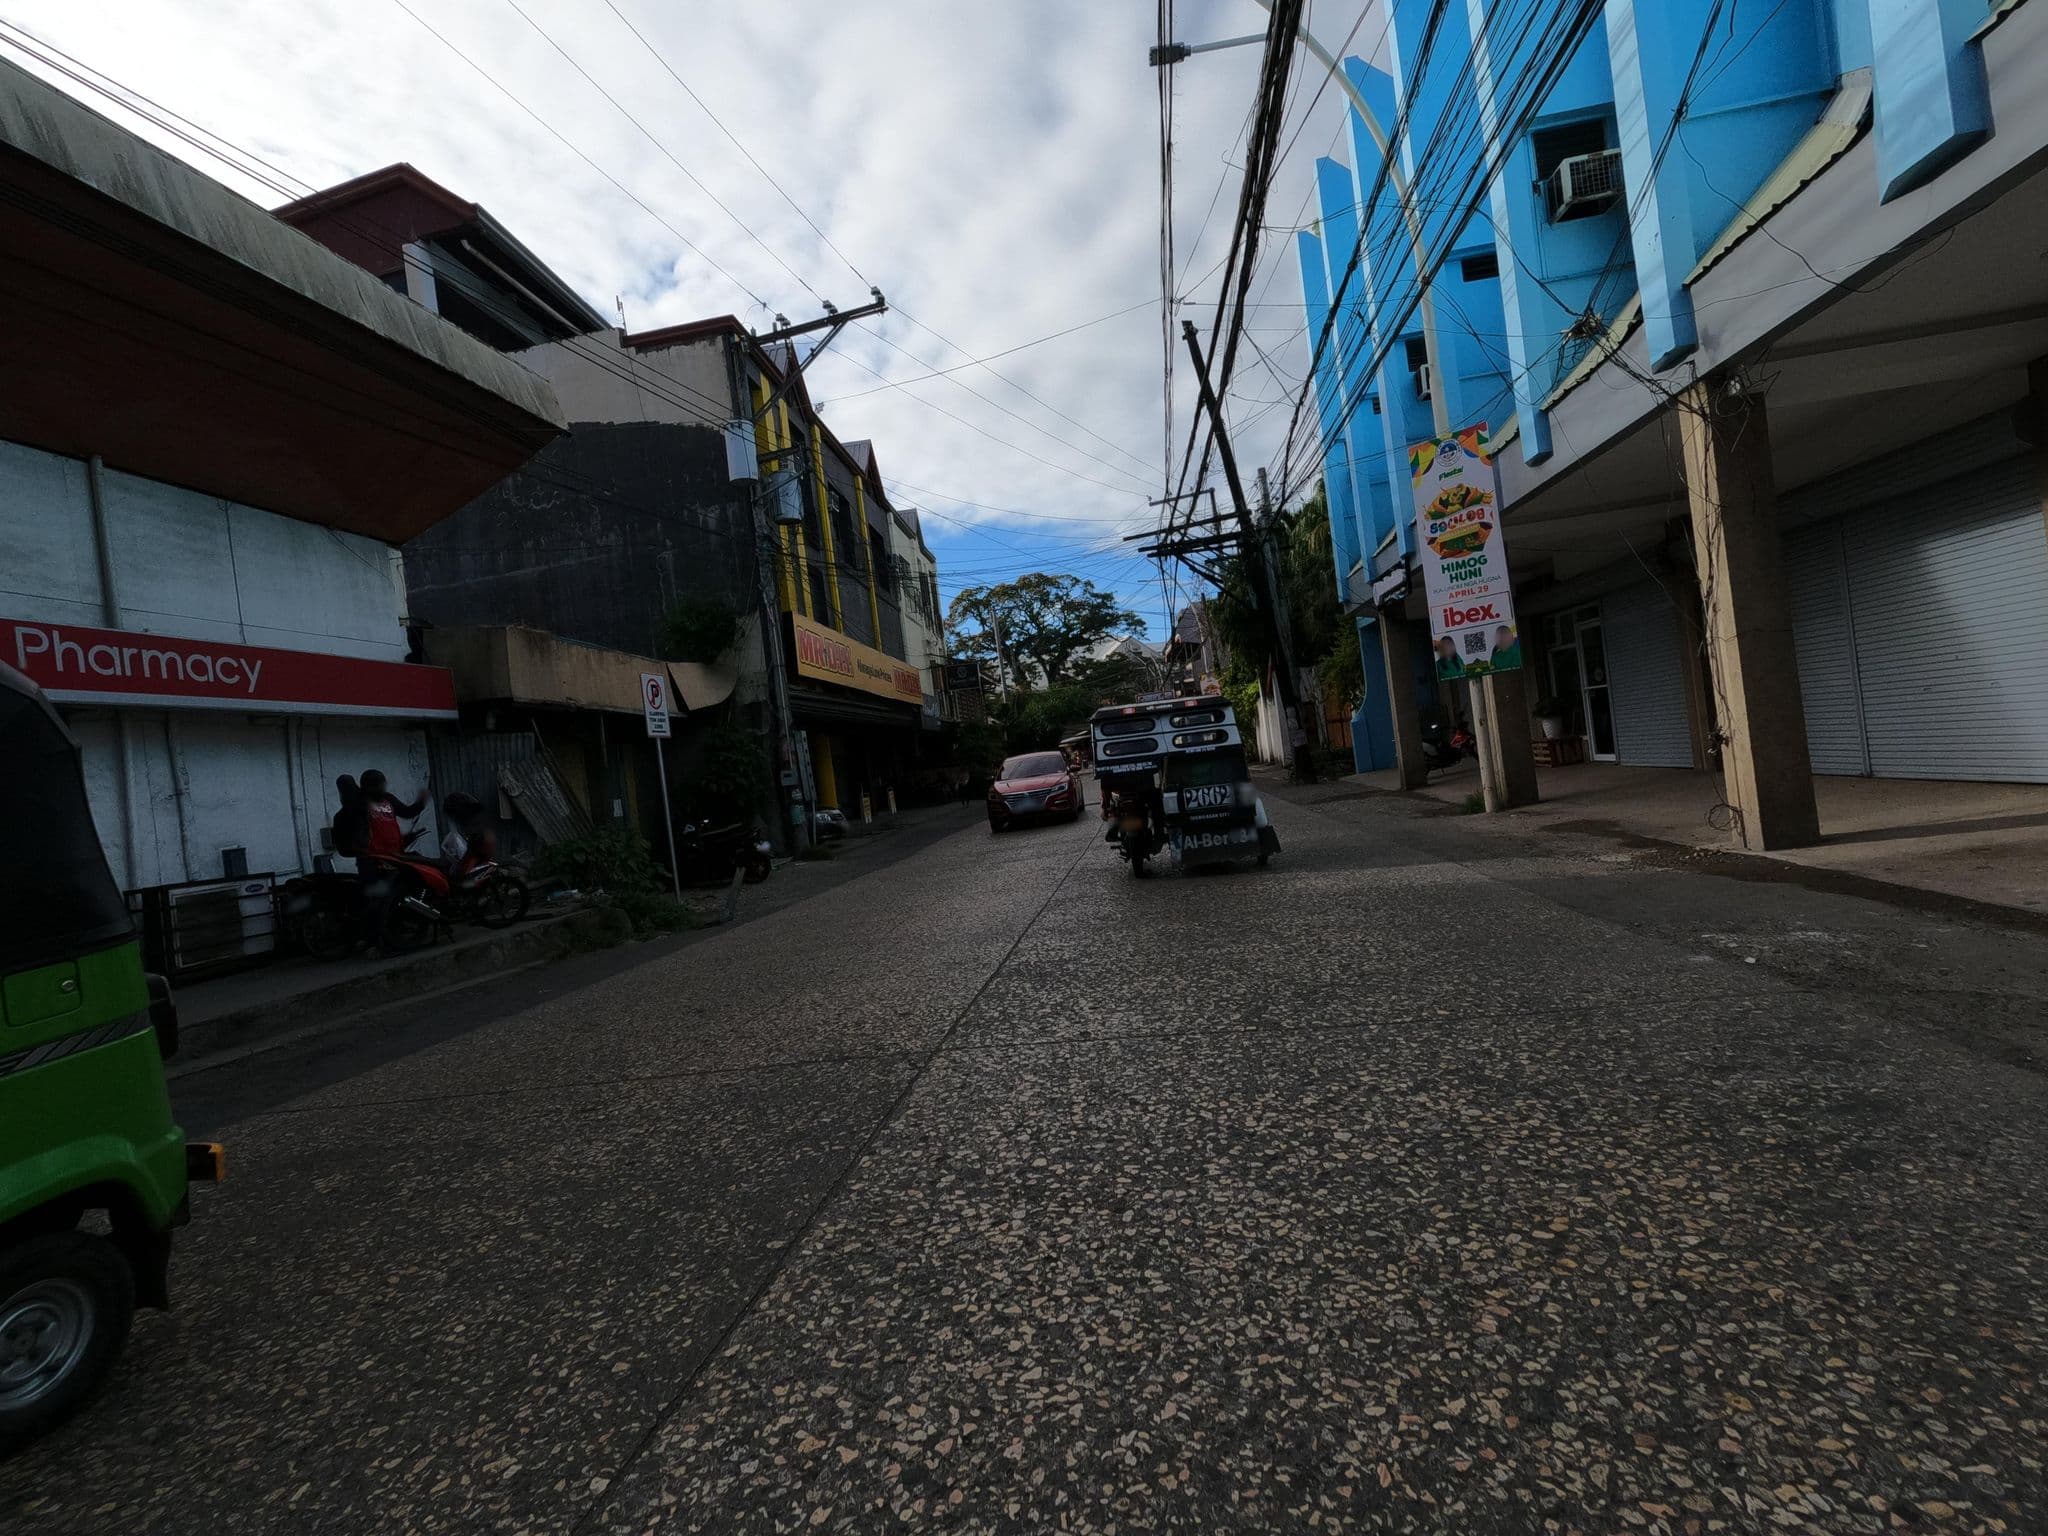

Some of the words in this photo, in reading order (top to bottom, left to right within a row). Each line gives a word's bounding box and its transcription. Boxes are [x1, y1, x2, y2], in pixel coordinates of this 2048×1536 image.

[1441, 554, 1488, 575] HIMOG
[1449, 567, 1482, 584] HUNI
[1448, 588, 1476, 600] APRIL
[1442, 602, 1501, 629] ibex.
[14, 626, 263, 694] Pharmacy
[1185, 785, 1233, 809] 2662
